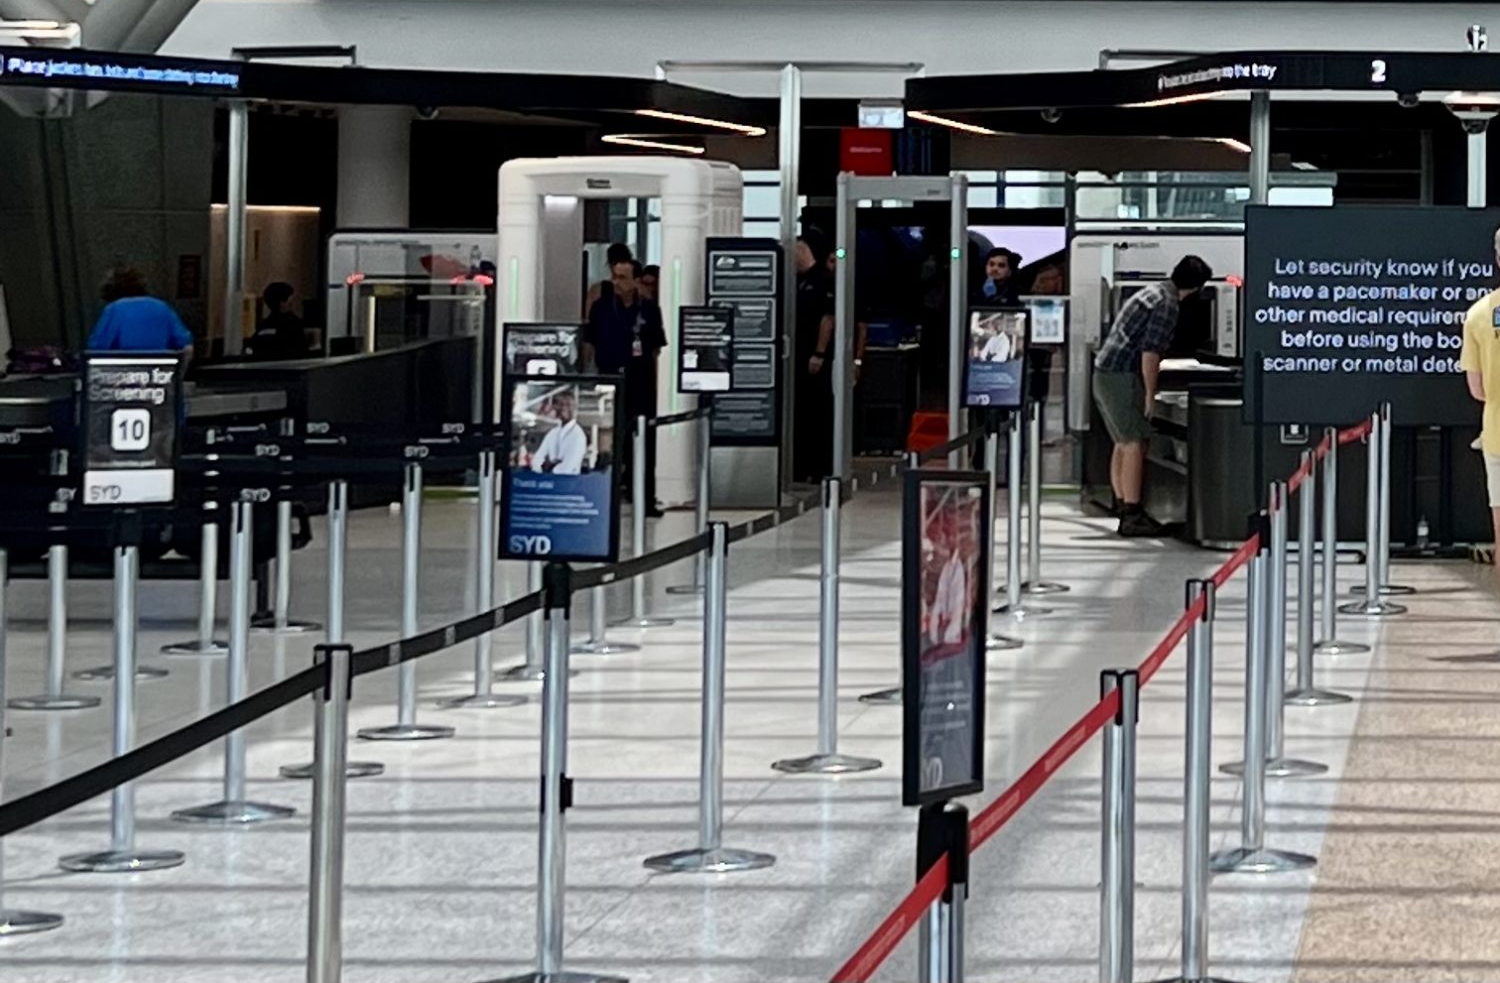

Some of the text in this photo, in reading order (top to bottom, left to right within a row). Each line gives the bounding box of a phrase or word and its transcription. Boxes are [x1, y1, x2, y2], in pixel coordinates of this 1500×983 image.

[1371, 60, 1386, 82] 2
[1275, 259, 1493, 280] Let security know if you
[1268, 282, 1314, 299] have
[1317, 286, 1329, 299] a
[1333, 283, 1438, 302] pacemaker
[1442, 287, 1462, 299] or
[1255, 307, 1305, 323] other
[1309, 307, 1383, 323] medical
[1281, 330, 1462, 351] before using the bo
[1263, 356, 1461, 373] scanner or metal dete
[89, 367, 175, 386] Prepare for
[89, 384, 165, 405] Screening
[119, 419, 145, 441] 10
[90, 485, 122, 501] SYD
[241, 488, 271, 502] SYD
[510, 535, 551, 554] SYD
